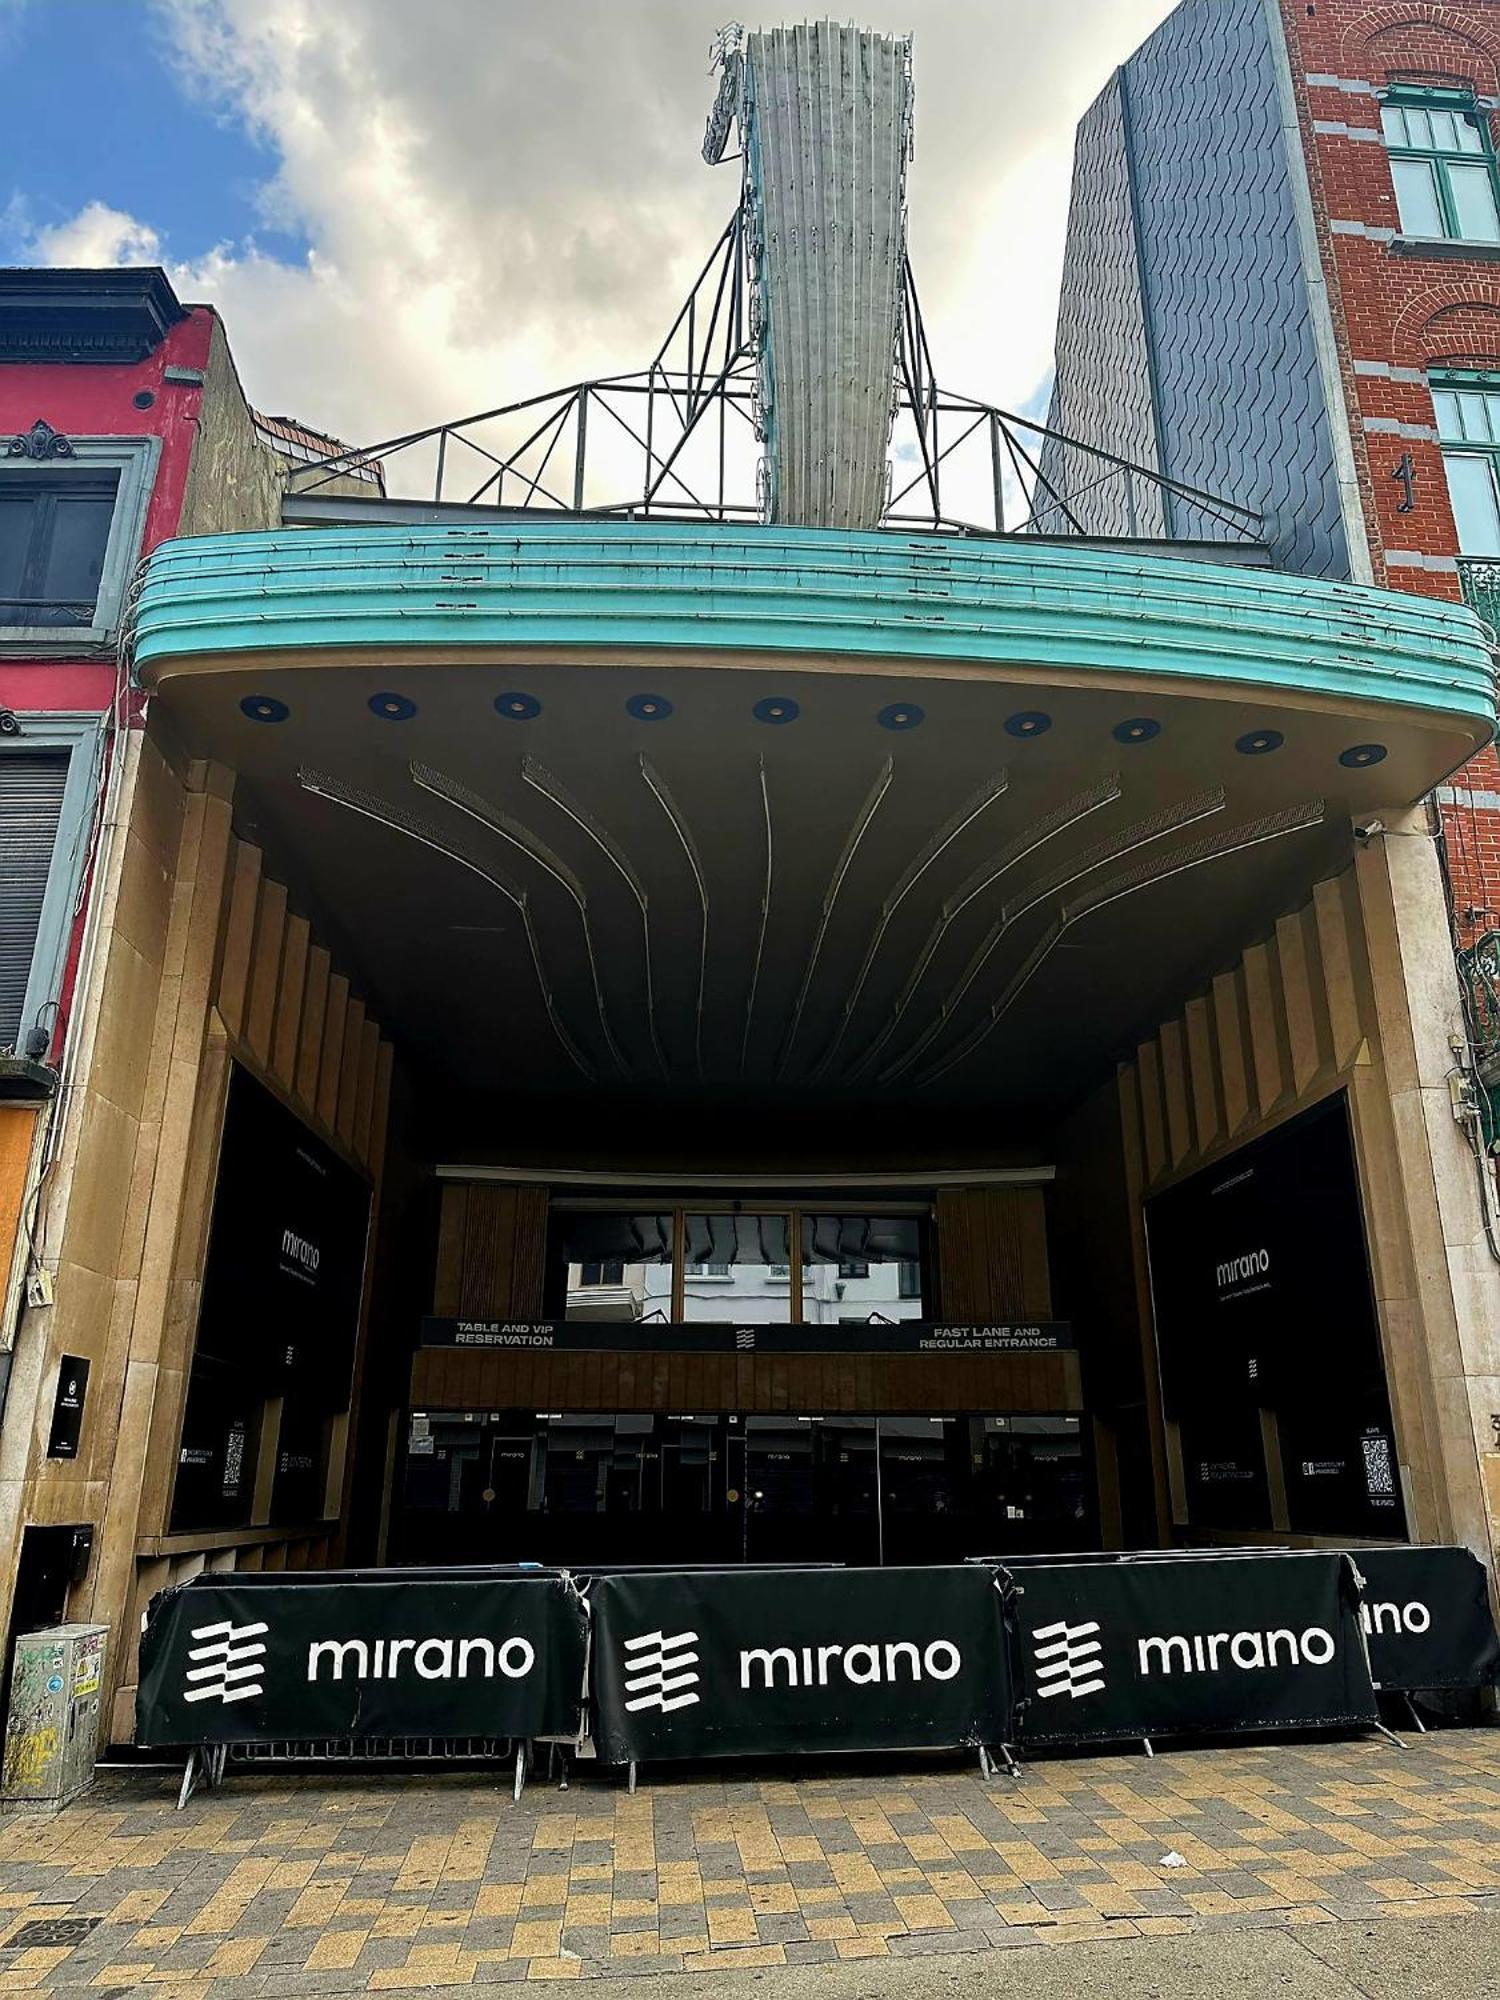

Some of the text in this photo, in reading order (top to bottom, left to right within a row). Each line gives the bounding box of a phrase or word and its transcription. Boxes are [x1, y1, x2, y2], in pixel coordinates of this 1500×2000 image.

[281, 1229, 320, 1270] mirano
[1216, 1248, 1269, 1287] mirano
[455, 1333, 553, 1346] RESERVATION
[457, 1322, 554, 1334] TABLE AND VIP
[920, 1338, 1057, 1349] REGULAR ENTRANCE
[934, 1327, 1041, 1337] FAST LANE AND
[308, 1636, 535, 1681] mirano
[740, 1639, 961, 1689] mirano
[1137, 1627, 1335, 1675] mirano
